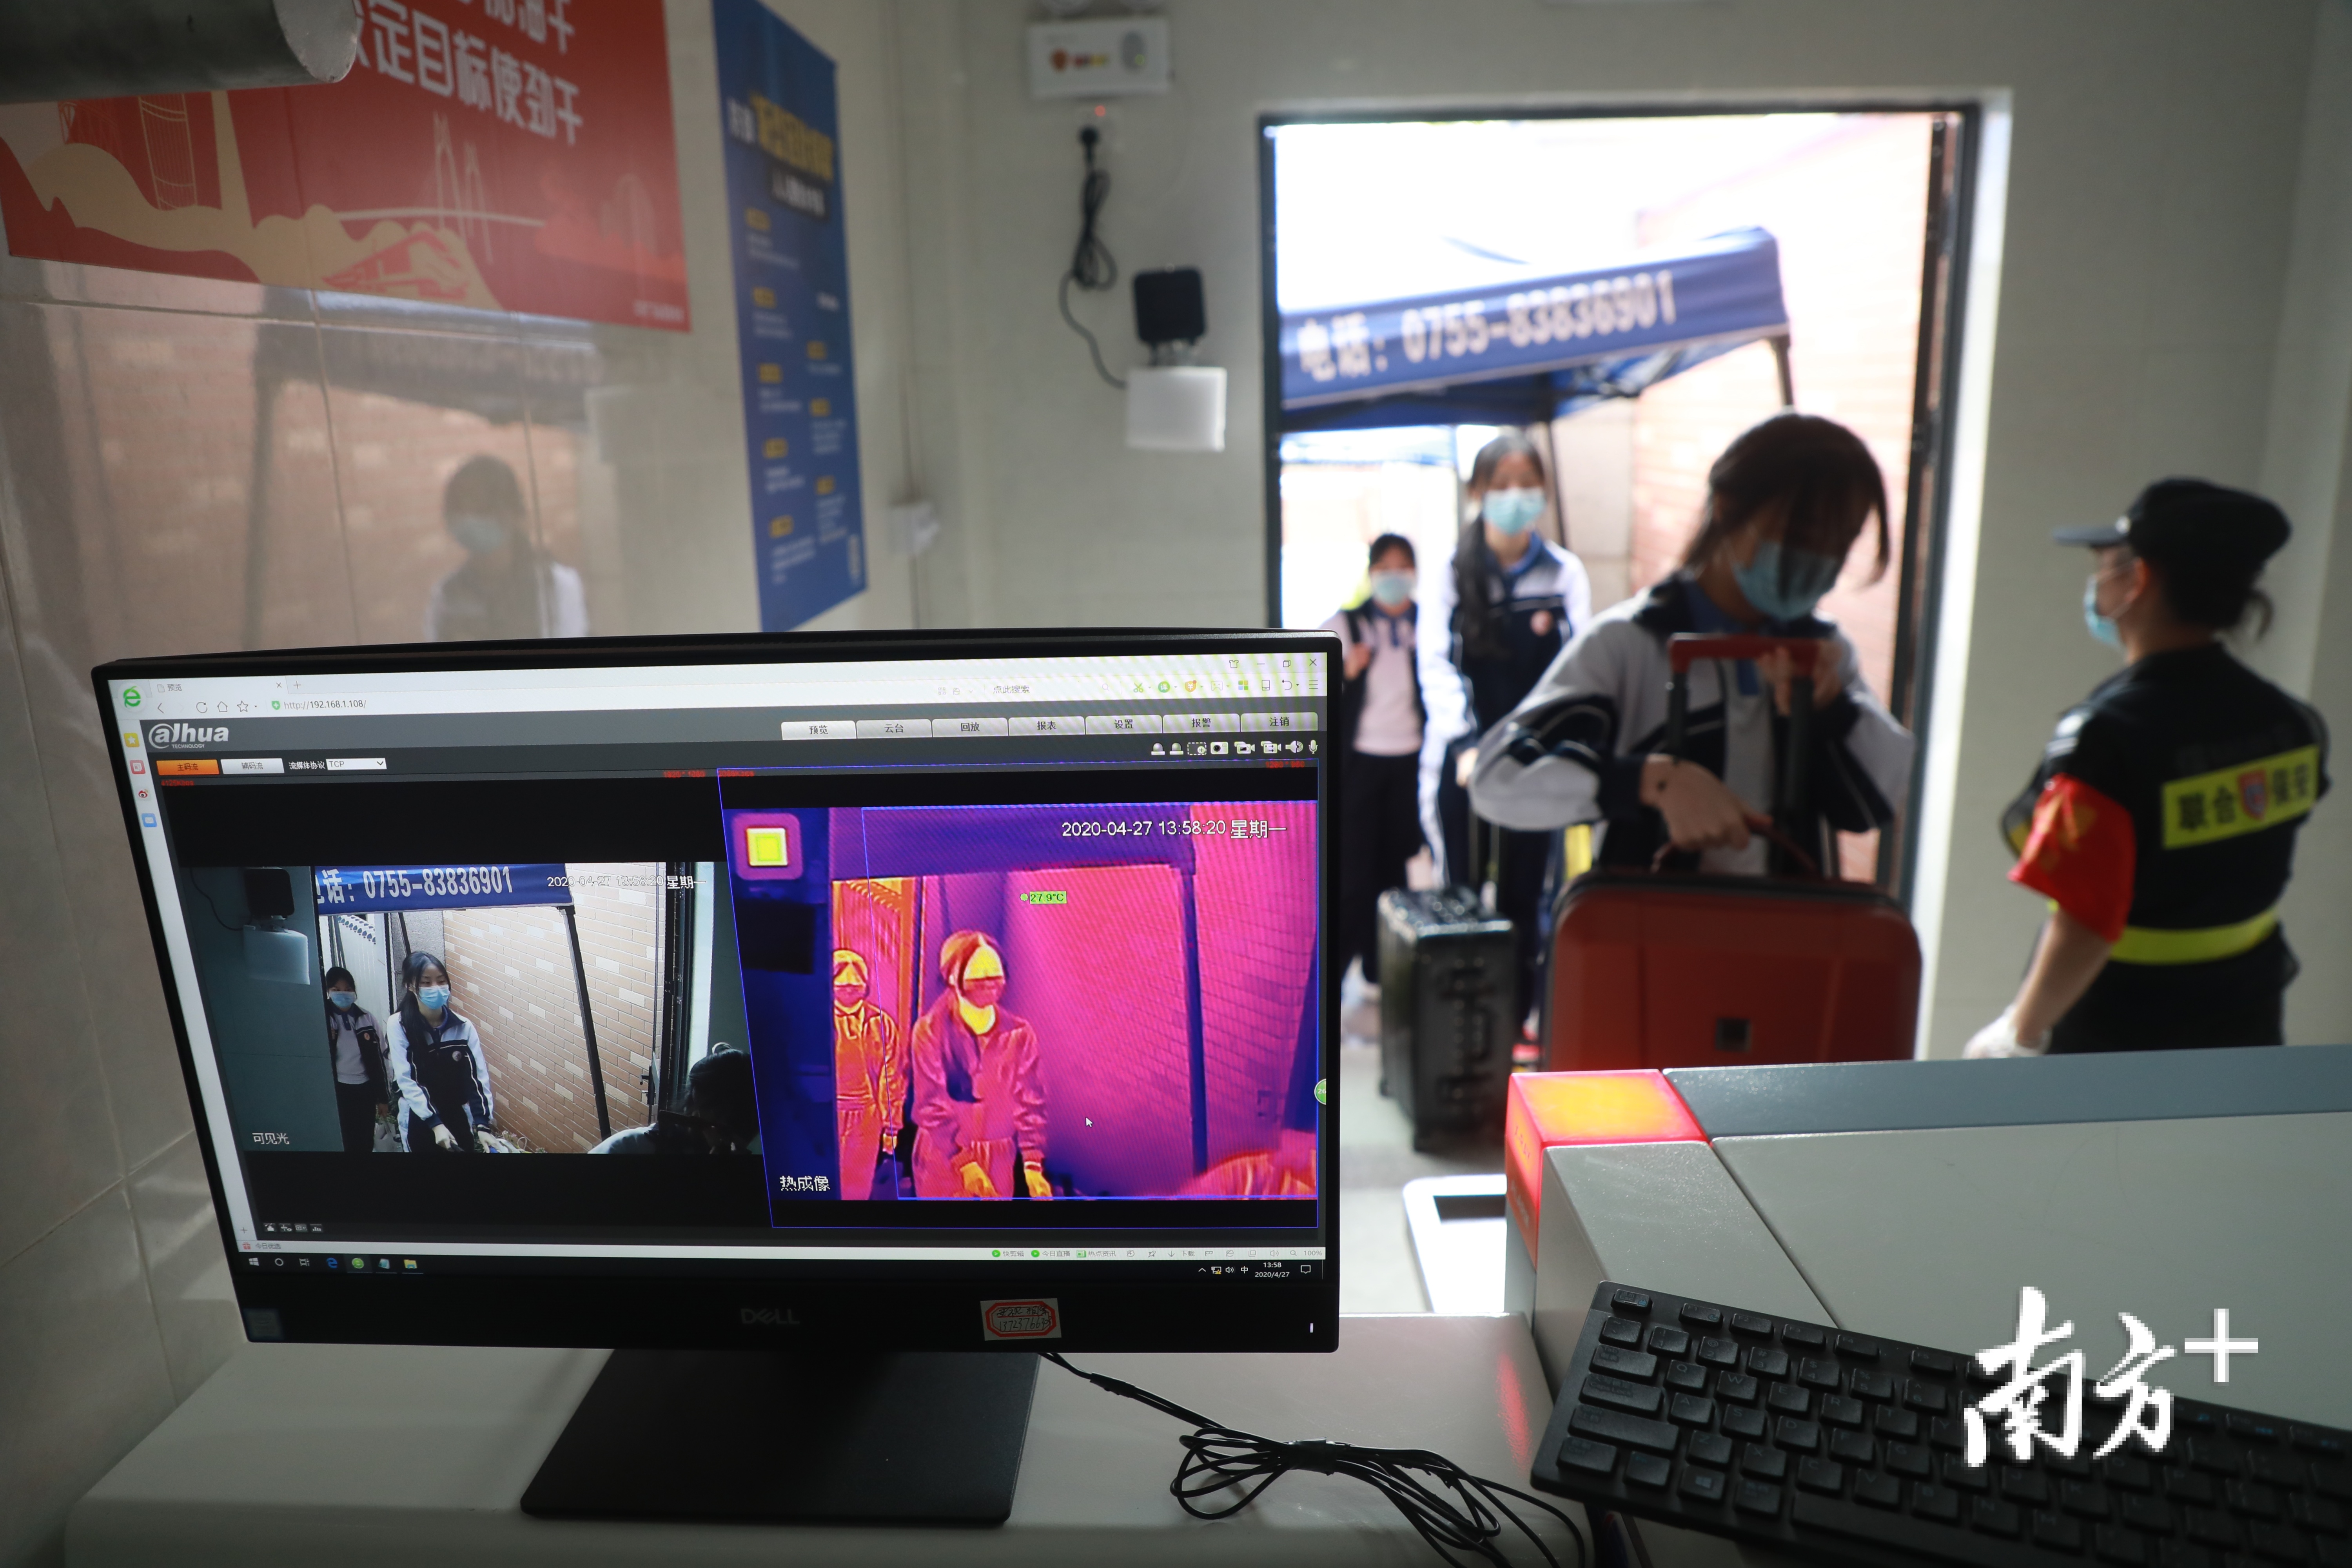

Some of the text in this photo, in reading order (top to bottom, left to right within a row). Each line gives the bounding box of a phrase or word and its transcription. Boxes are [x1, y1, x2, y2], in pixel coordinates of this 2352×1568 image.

[1401, 270, 1676, 363] 0755-83836901
[993, 685, 1030, 695] 点此搜索
[284, 700, 366, 710] http://192.168.1.108/
[961, 722, 980, 731] 回放
[1036, 720, 1057, 731] 报表
[1114, 719, 1134, 729] 设置
[1192, 718, 1211, 728] 报警
[1269, 717, 1289, 727] 注销
[809, 725, 828, 735] 预览
[884, 723, 904, 733] 云台
[178, 763, 199, 771] 主码流
[289, 761, 325, 769] 流媒体协议
[1062, 819, 1287, 839] 2020-04-27 13:58:20 星期一
[363, 866, 513, 898] 0755-83836901
[547, 875, 706, 889] 2020-04-27 13:58:20 星期一
[252, 1132, 290, 1145] 可见光
[780, 1176, 830, 1191] 热成像
[740, 1308, 800, 1325] DELL
[1728, 1374, 1744, 1384] W
[1831, 1397, 1840, 1406] R
[1753, 1447, 1762, 1457] X
